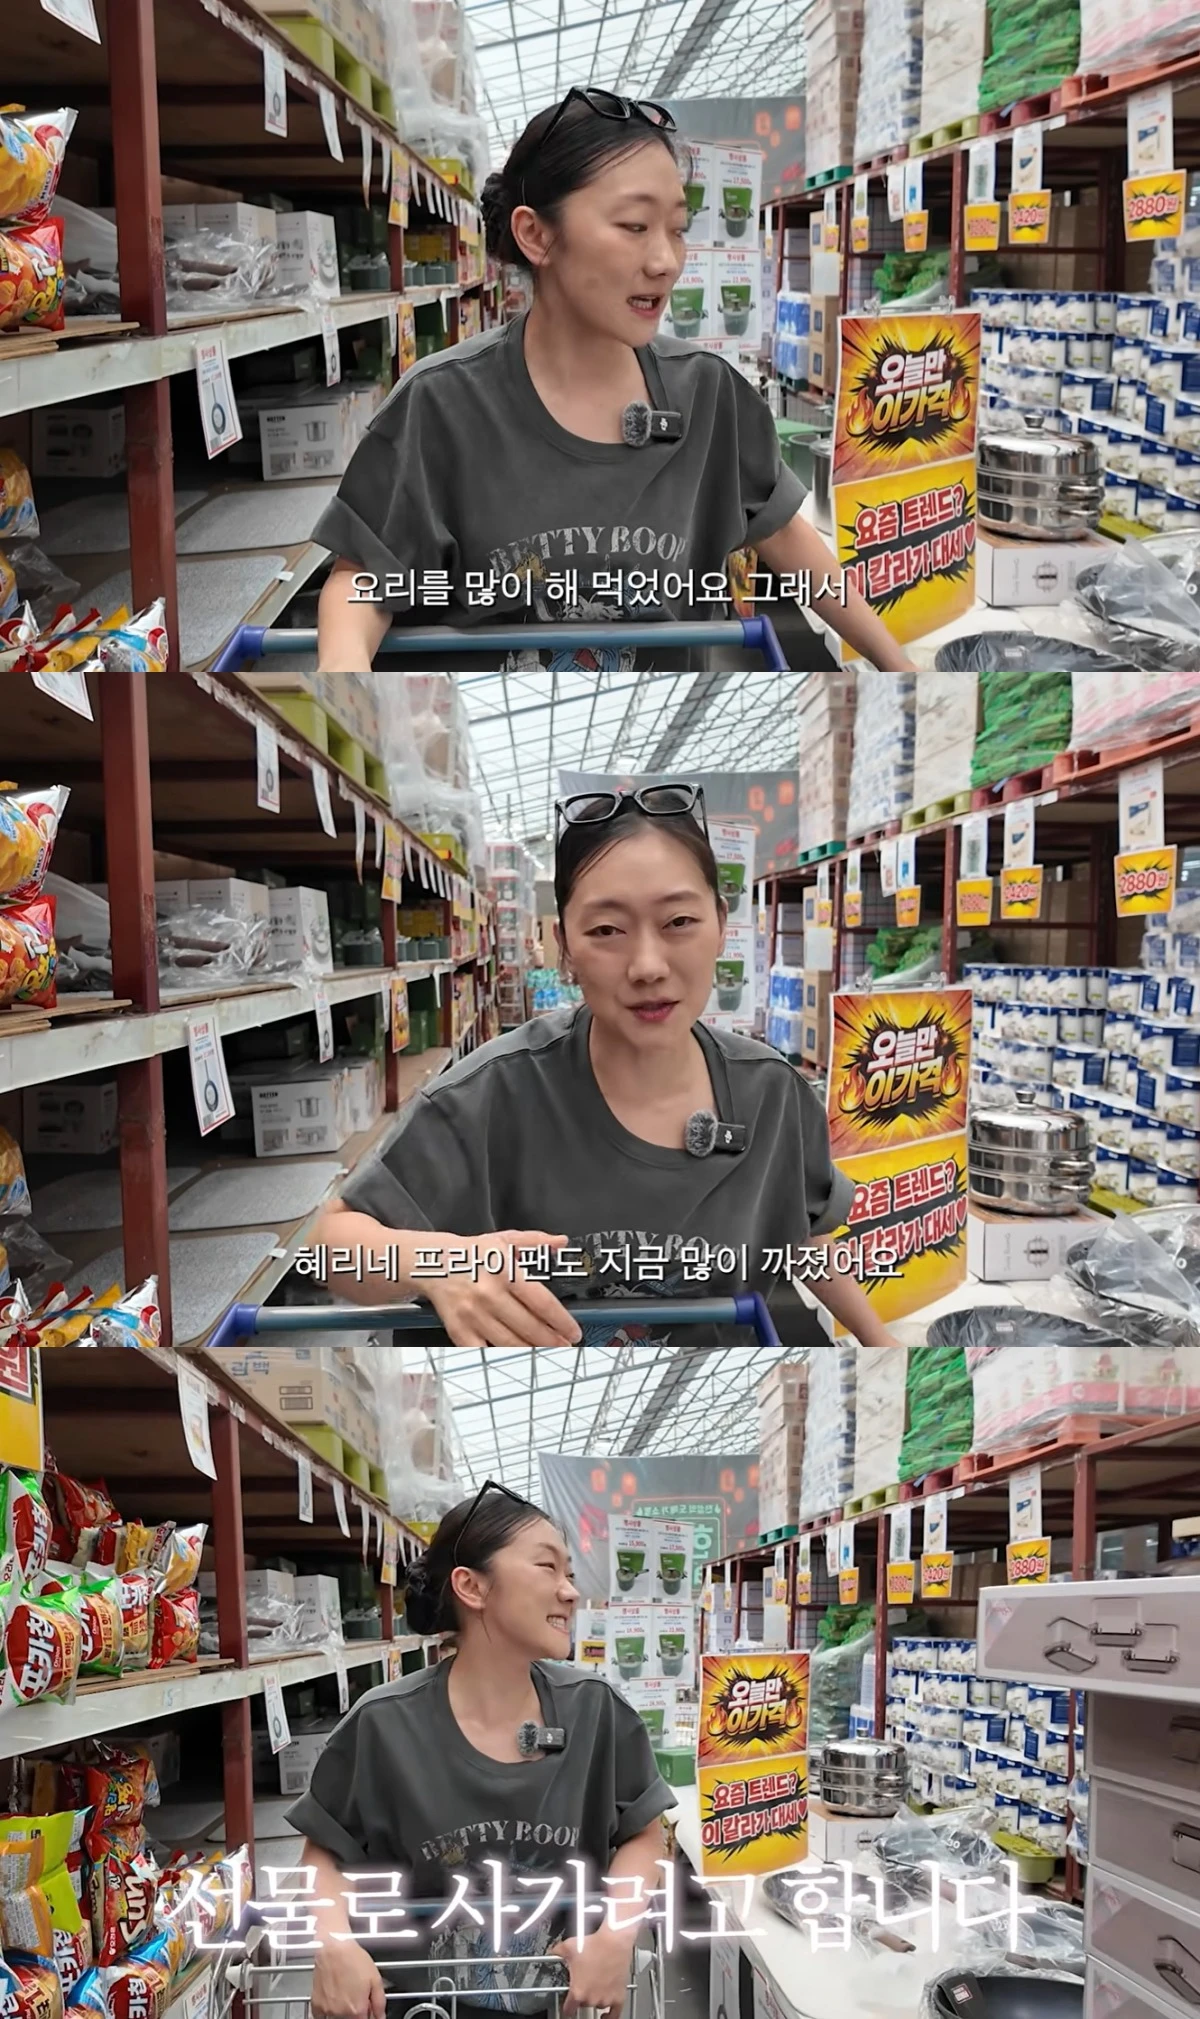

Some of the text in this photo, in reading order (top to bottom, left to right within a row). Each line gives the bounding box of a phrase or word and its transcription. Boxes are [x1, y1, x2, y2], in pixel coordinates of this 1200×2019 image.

[1127, 195, 1180, 221] 2880원
[875, 348, 947, 396] 오늘만
[870, 376, 953, 435] 이가격
[854, 484, 966, 550] 요즘 트렌드?
[610, 525, 686, 563] BOOP
[868, 543, 931, 599] 칼라가
[930, 532, 966, 572] 대세
[1119, 869, 1169, 895] 2880원
[867, 1024, 939, 1072] 오늘만
[864, 1054, 945, 1109] 이가격
[847, 1158, 958, 1226] 요즘 트렌드?
[922, 1201, 957, 1247] 대세
[21, 1610, 55, 1698] 포카칩
[728, 1677, 783, 1708] 오늘만
[726, 1698, 787, 1736] 이가격
[713, 1771, 798, 1811] 요즘 트렌드?
[514, 1820, 581, 1848] BOOP
[701, 1802, 799, 1846] 이 칼라가 대세
[119, 1874, 148, 1945] Sun
